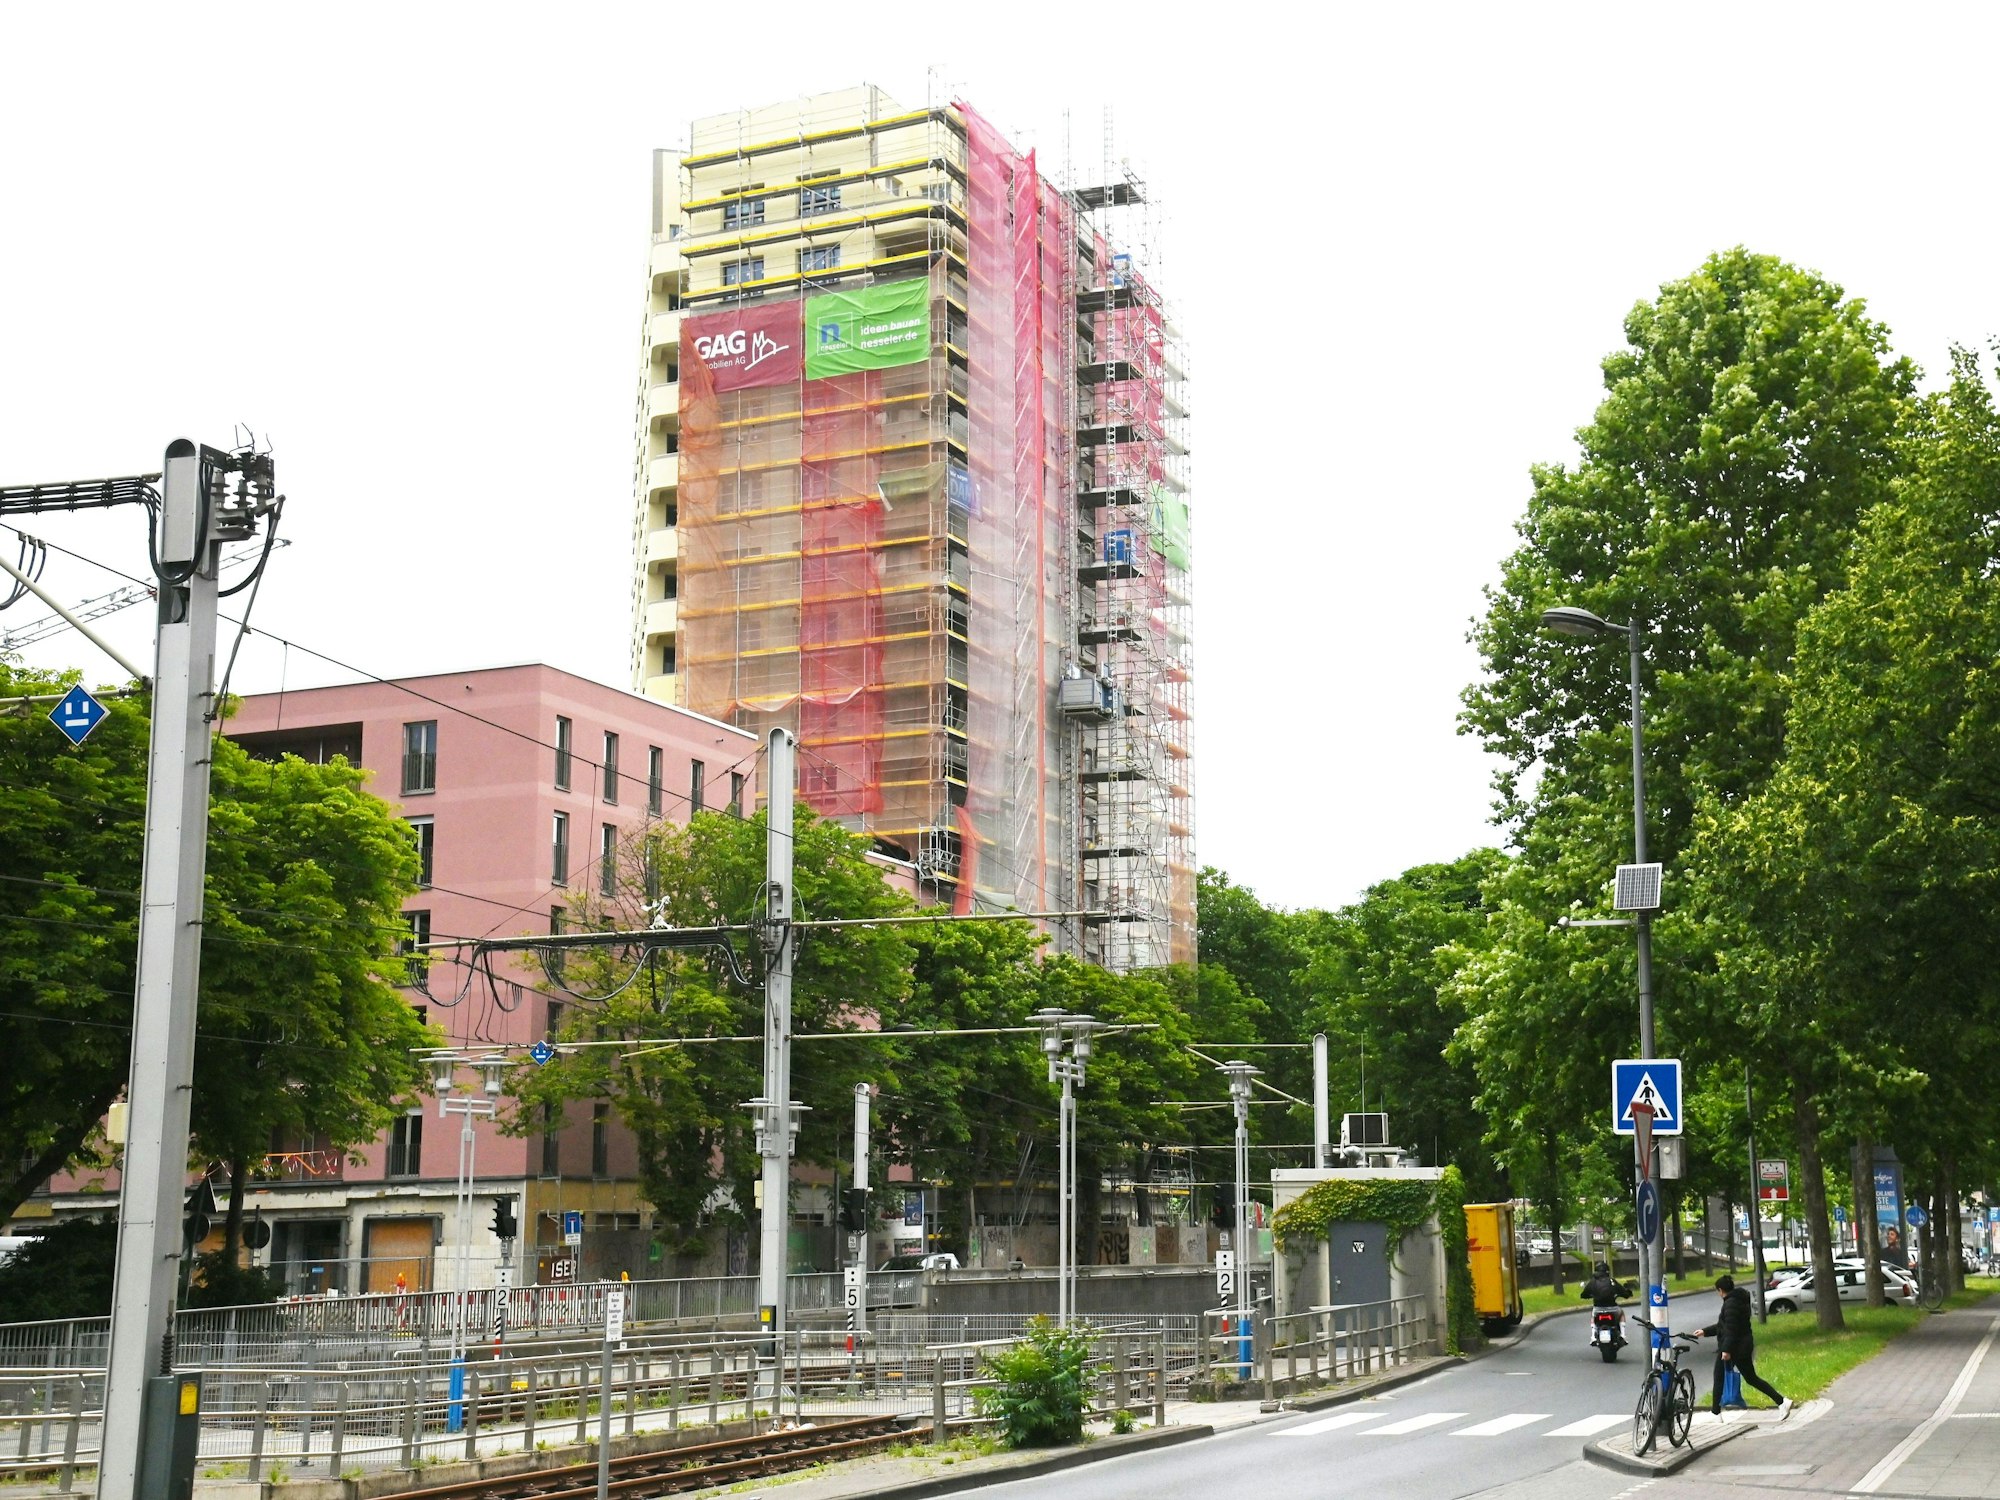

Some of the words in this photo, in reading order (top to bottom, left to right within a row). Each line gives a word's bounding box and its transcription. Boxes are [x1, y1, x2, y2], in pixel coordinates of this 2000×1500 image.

[860, 324, 888, 336] ideen
[890, 318, 921, 331] bauen
[694, 330, 746, 360] GAG
[860, 331, 918, 350] nesseler.de
[735, 356, 746, 365] AG
[1220, 1273, 1230, 1291] 2
[497, 1289, 507, 1306] 2
[847, 1288, 857, 1306] 5
